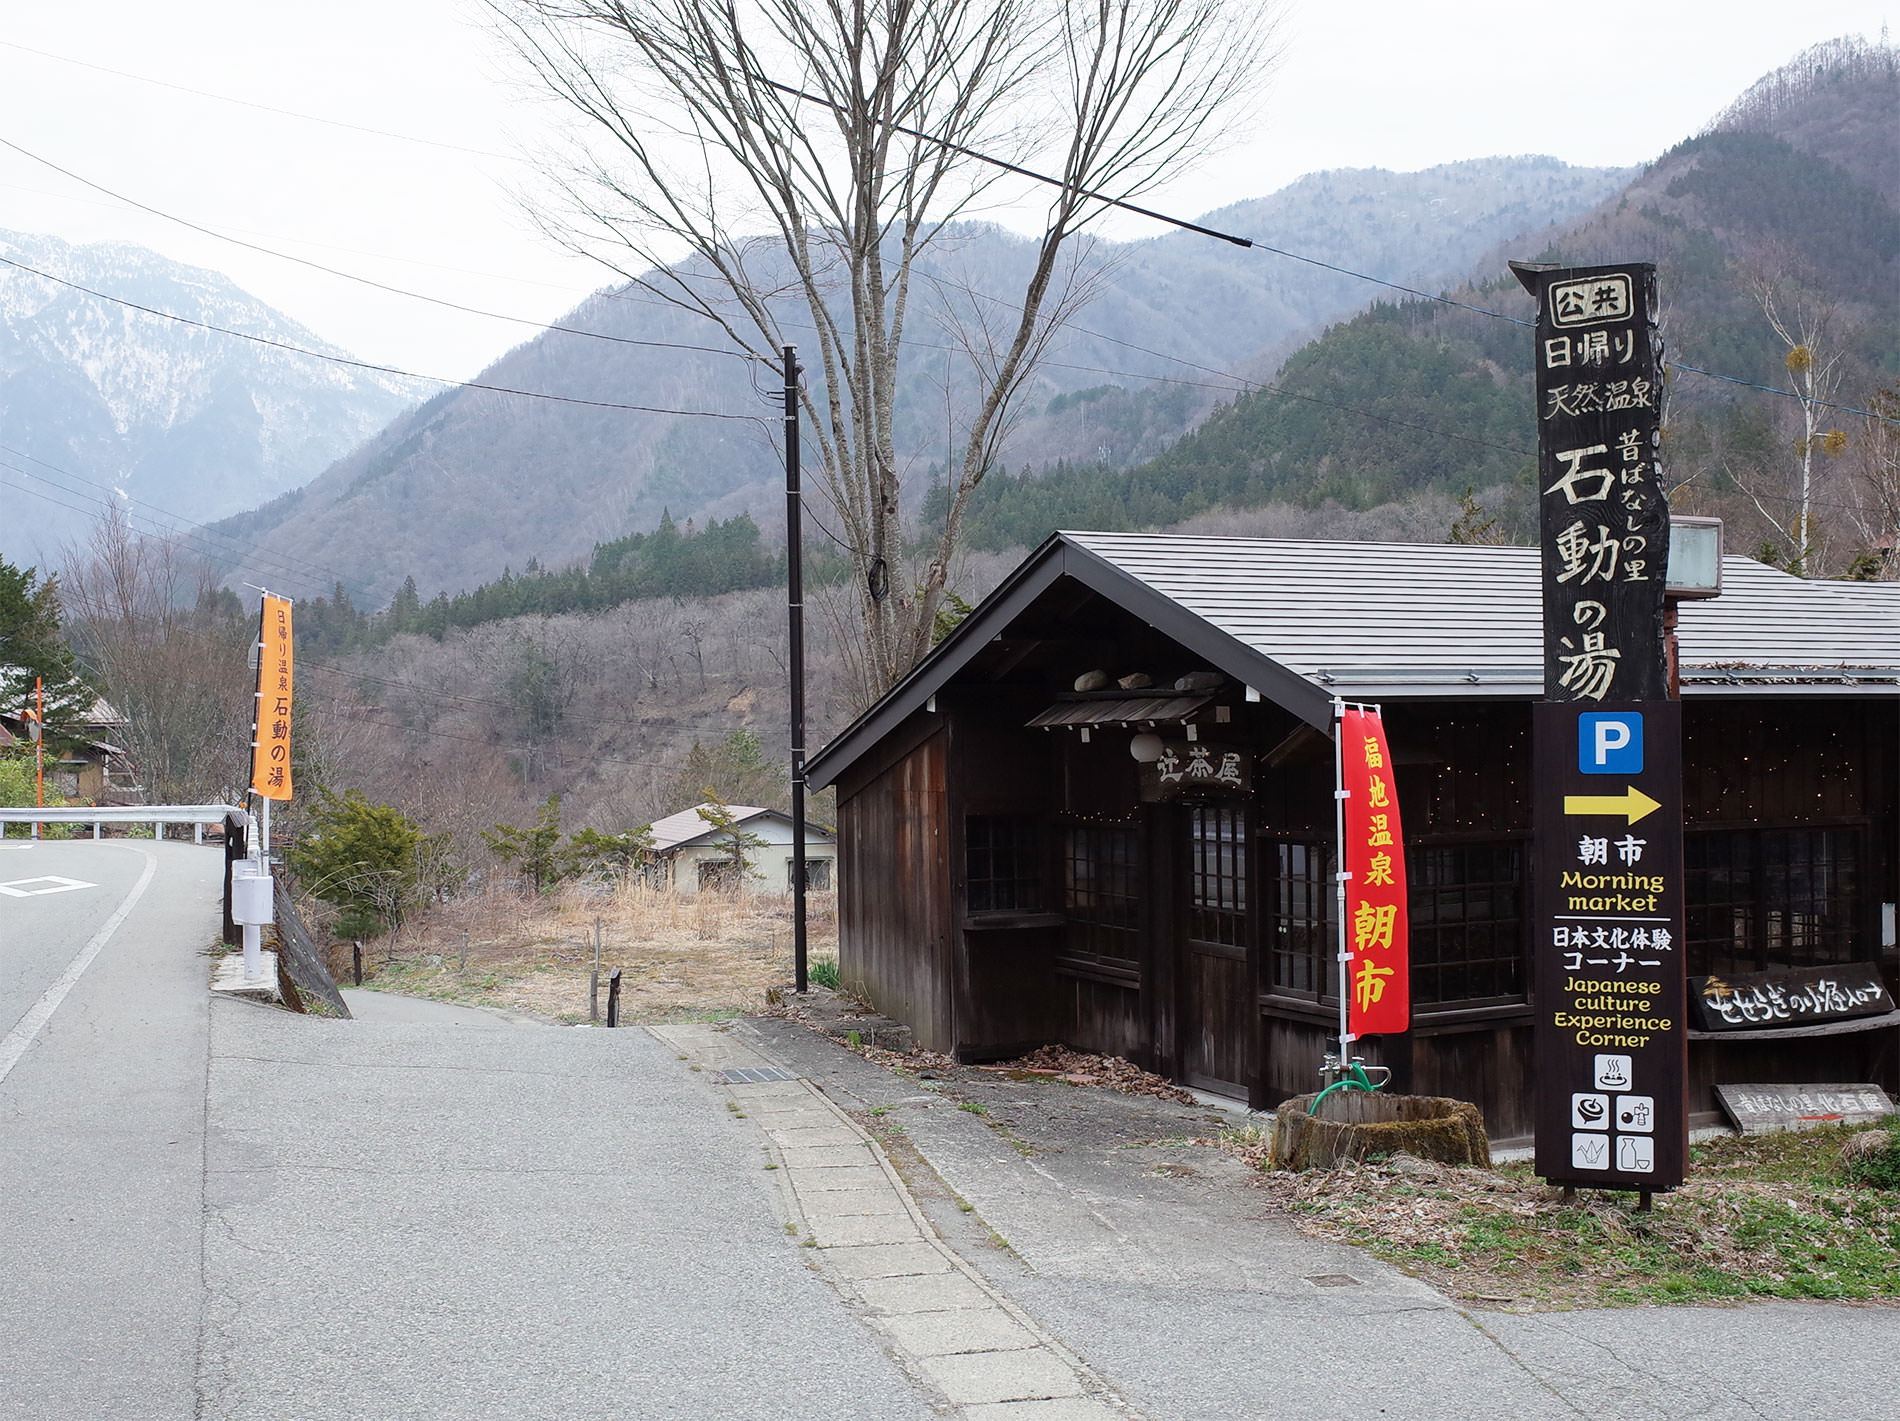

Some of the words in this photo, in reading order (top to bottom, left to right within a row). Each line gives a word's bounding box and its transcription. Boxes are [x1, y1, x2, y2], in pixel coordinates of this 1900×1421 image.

[1558, 285, 1619, 317] 公共
[1545, 329, 1634, 368] 日帰り
[1543, 376, 1652, 420] 天然温泉
[1615, 428, 1649, 582] 昔ばなしの里
[1543, 444, 1622, 702] 石動の湯
[1595, 721, 1631, 765] P
[1157, 746, 1242, 785] 辻茶屋
[1577, 834, 1647, 867] 朝市
[1560, 871, 1665, 893] Morning
[1568, 894, 1658, 912] market
[1552, 926, 1673, 951] 日本文化体験
[1563, 951, 1662, 974] コーナー
[1564, 976, 1661, 995] Japanese
[1574, 995, 1651, 1012] culture
[1554, 1012, 1672, 1031] Experience
[1576, 1031, 1650, 1048] Corner
